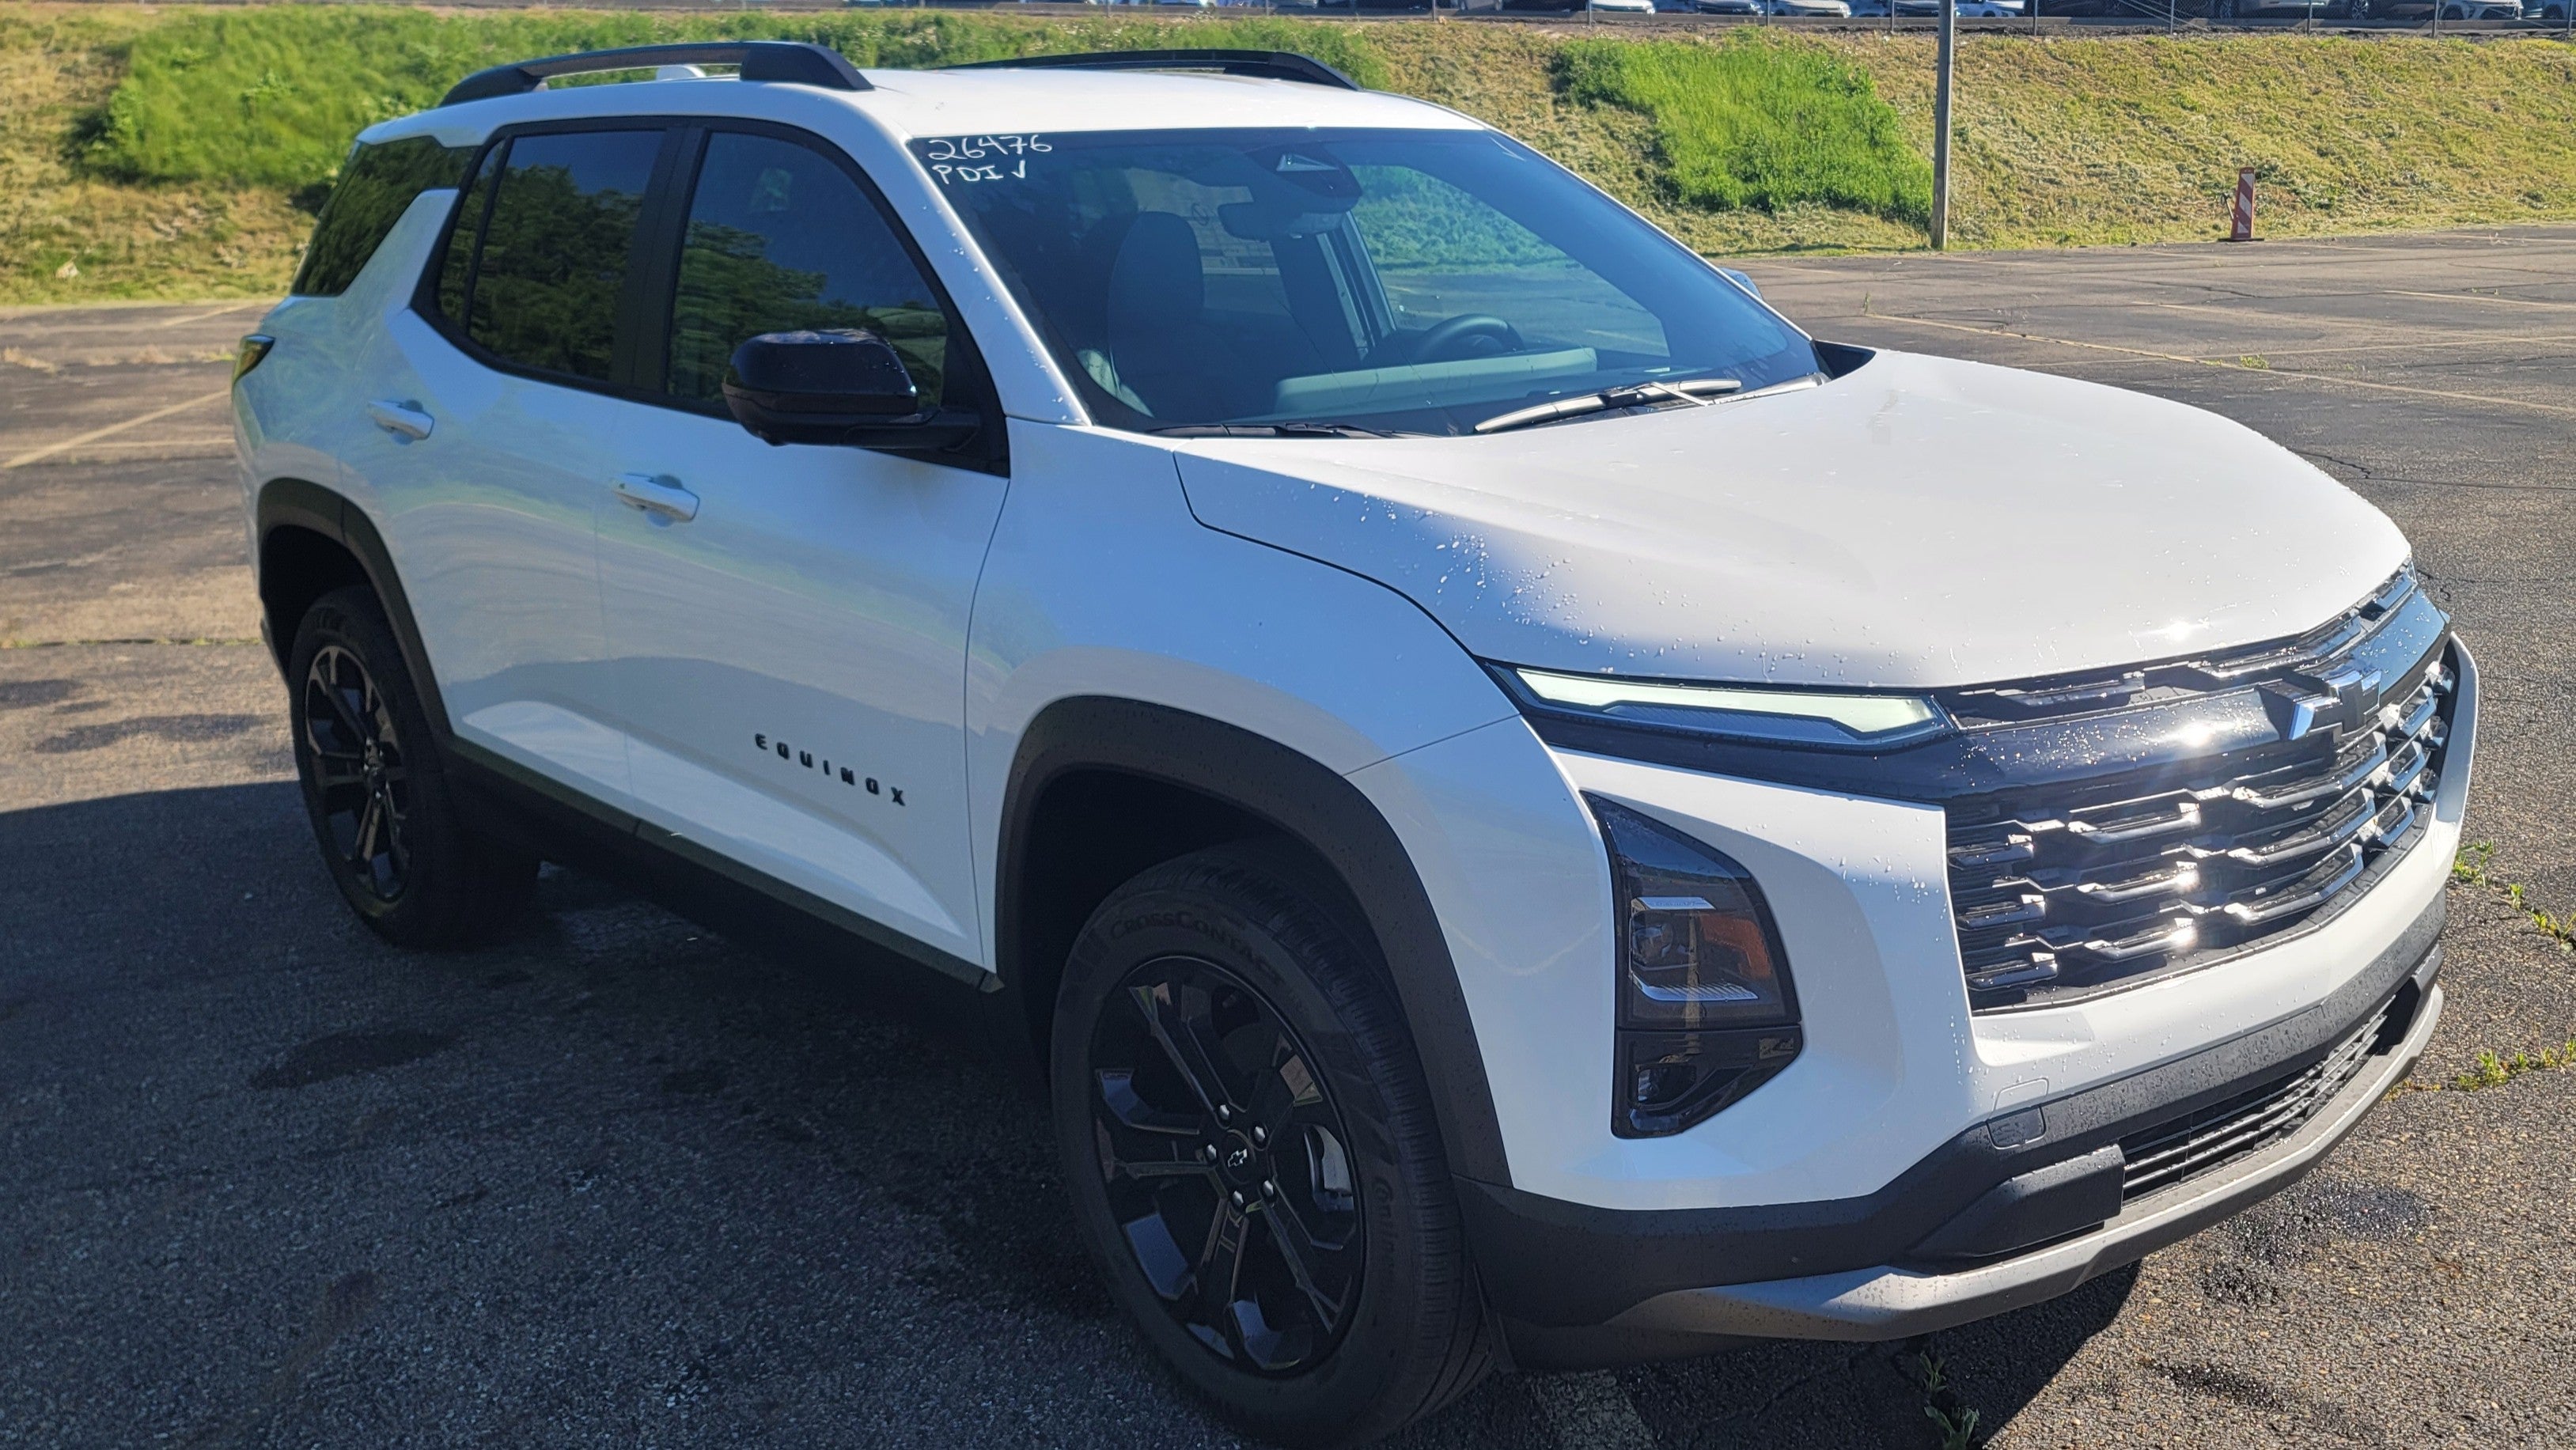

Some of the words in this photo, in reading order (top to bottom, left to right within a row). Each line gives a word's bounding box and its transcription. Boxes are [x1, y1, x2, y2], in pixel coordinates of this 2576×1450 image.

[927, 134, 1053, 161] 26476
[931, 164, 1005, 185] PDI
[754, 733, 906, 807] EQUINOX
